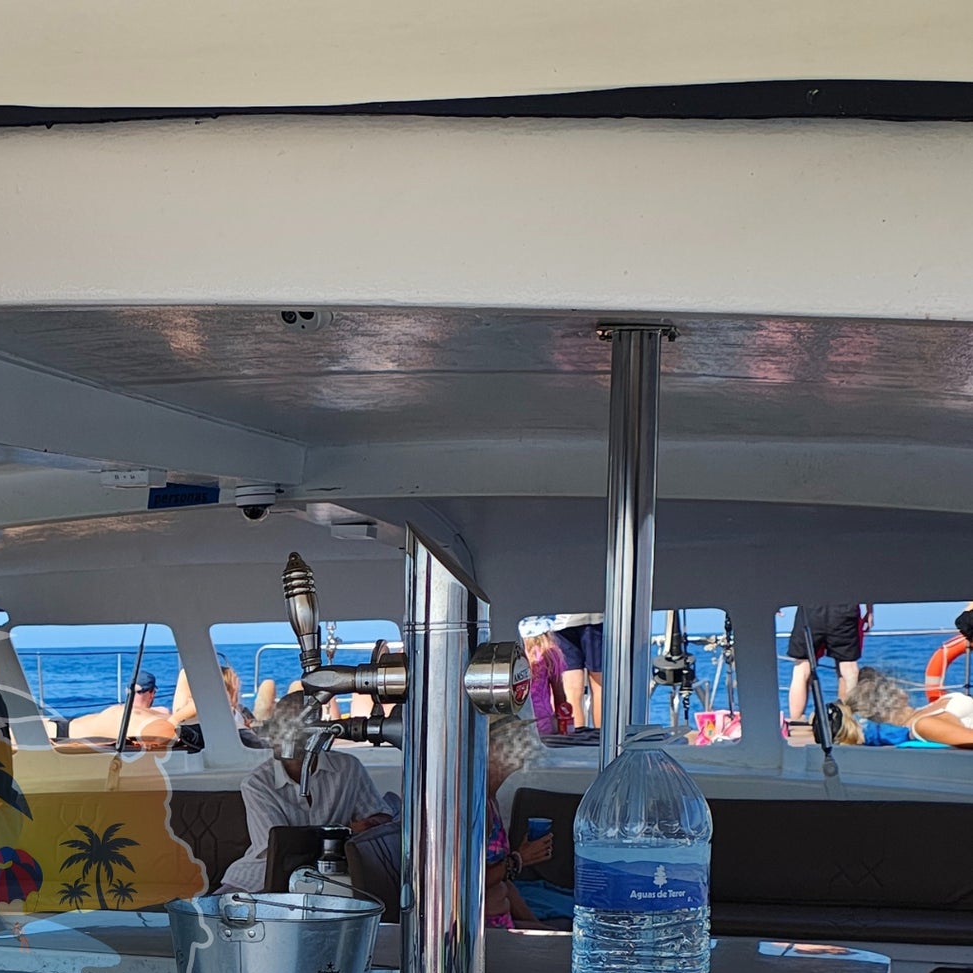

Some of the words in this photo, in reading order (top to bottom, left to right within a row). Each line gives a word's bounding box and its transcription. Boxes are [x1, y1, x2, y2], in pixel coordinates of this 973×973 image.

[629, 890, 656, 900] Aguas
[656, 889, 667, 898] de
[667, 889, 687, 898] Teror
